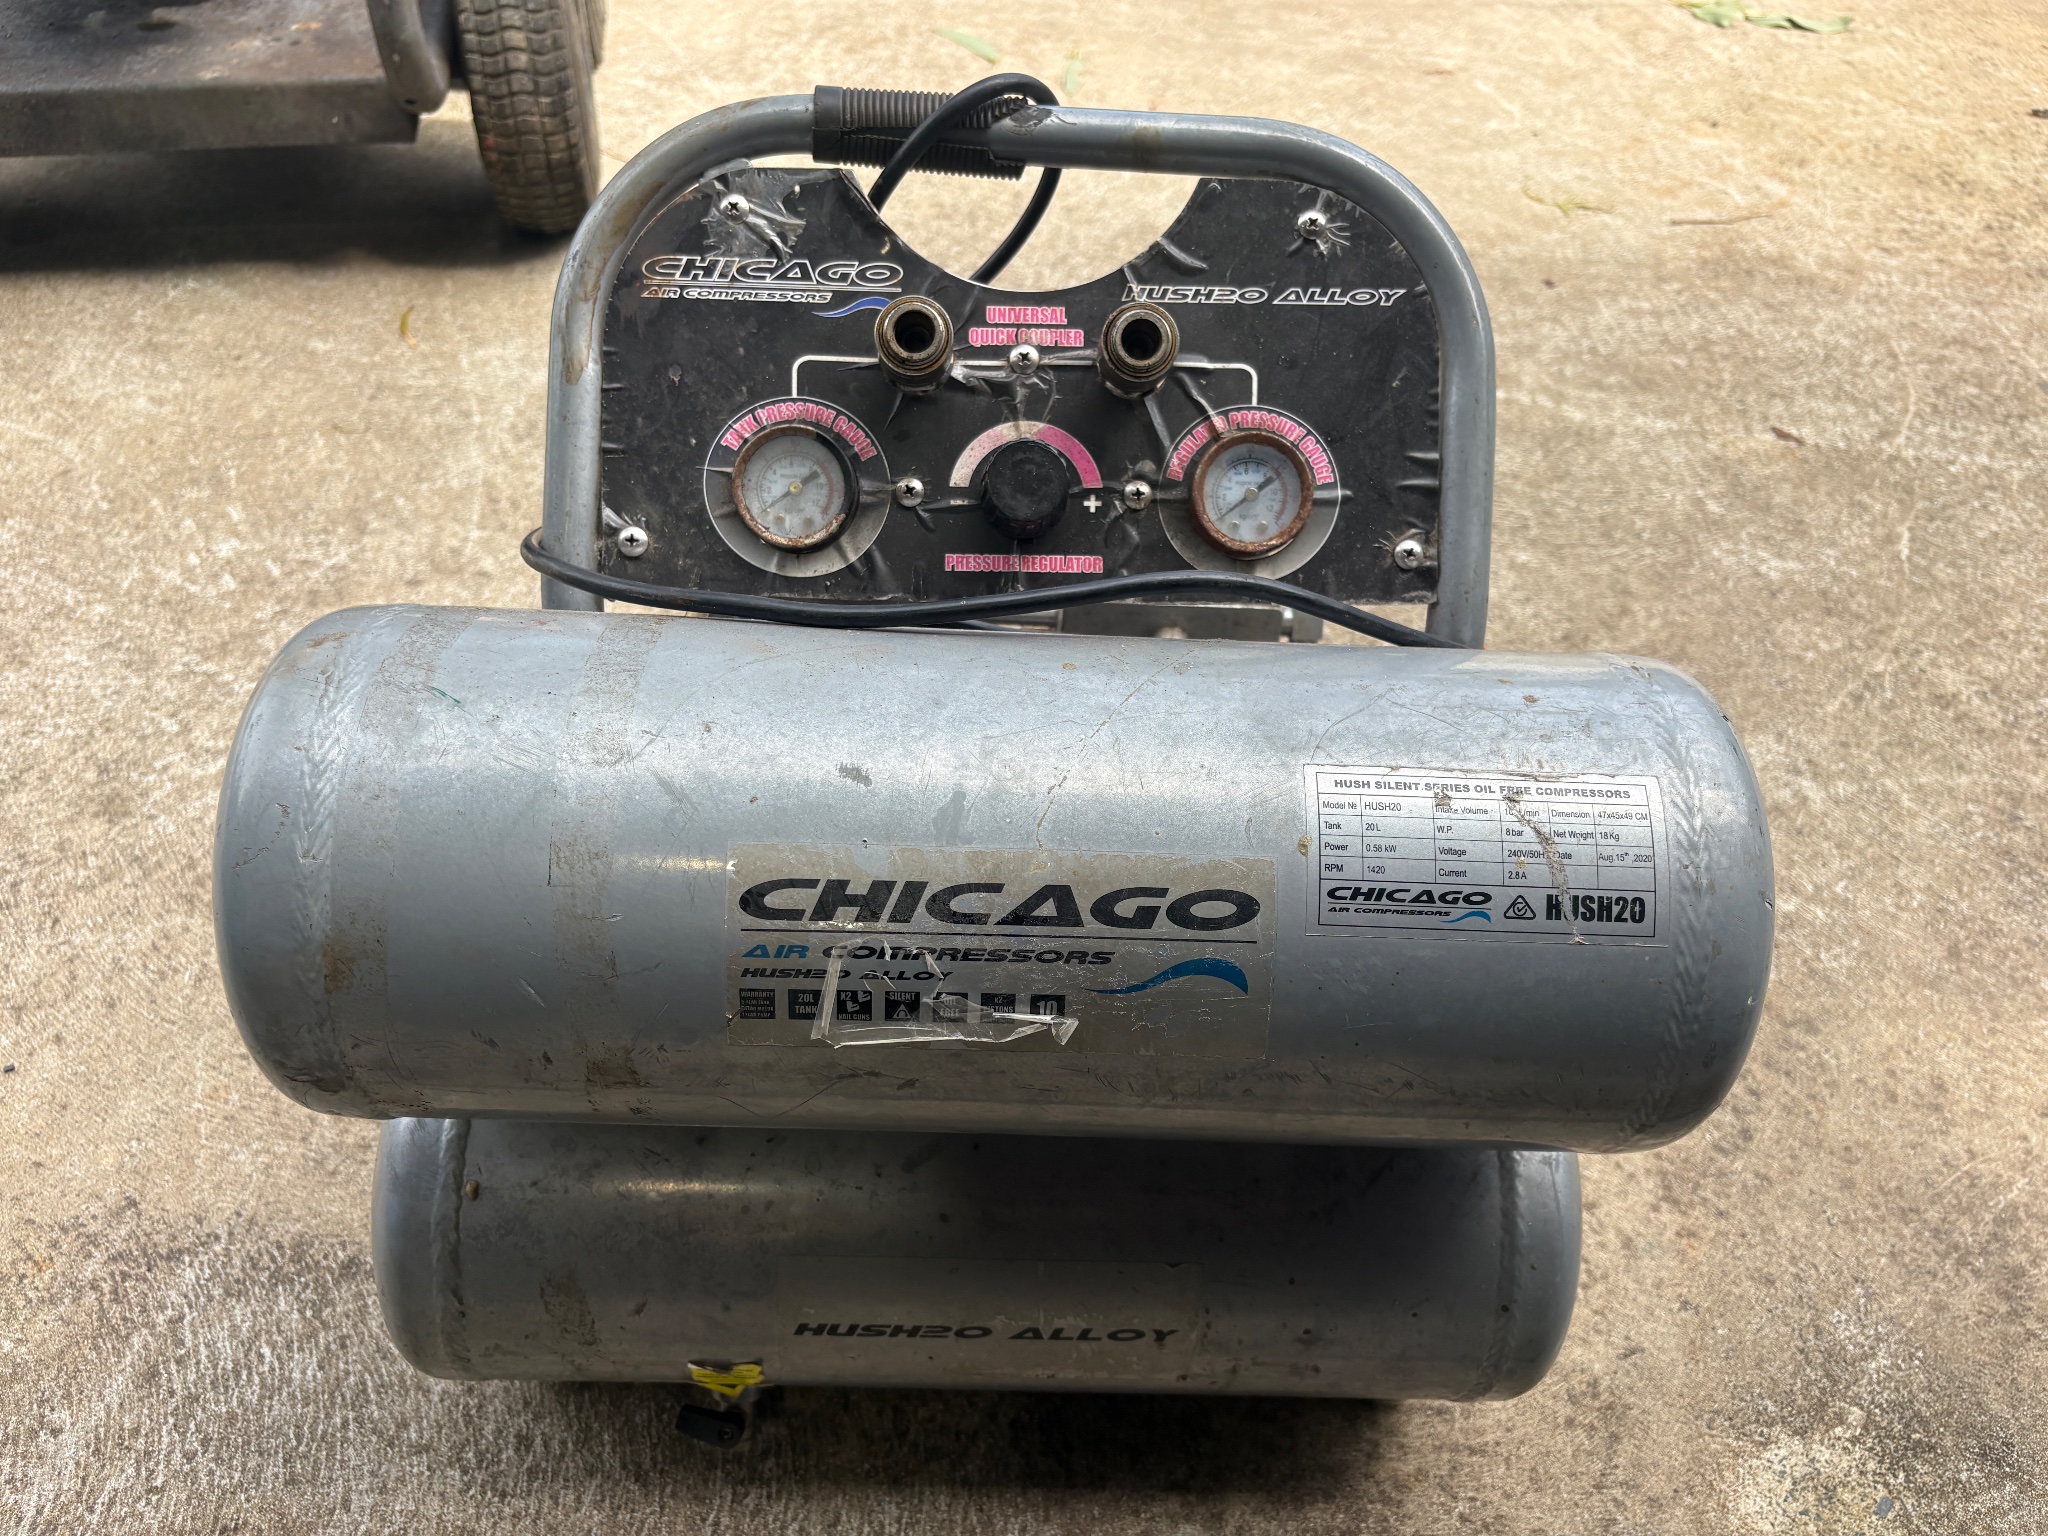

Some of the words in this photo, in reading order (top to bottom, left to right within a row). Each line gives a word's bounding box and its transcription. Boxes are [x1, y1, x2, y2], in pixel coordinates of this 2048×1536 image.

[641, 255, 904, 287] CHICAGO
[641, 287, 680, 298] AIR
[683, 288, 833, 303] COMPRESSORS
[1120, 284, 1269, 304] HUSH20
[1272, 287, 1407, 306] ALLOY
[986, 306, 1067, 325] UNIVERSAL
[968, 328, 1017, 347] QUICK
[1018, 329, 1085, 347] COUPLER
[720, 413, 760, 451] TANK
[755, 402, 837, 428] PRESSURE
[832, 415, 878, 462] GAUGE
[1228, 411, 1307, 444] PRESSURE
[1298, 436, 1335, 485] GAUGE
[945, 554, 1019, 572] PRESSURE
[1021, 555, 1104, 573] REGULATOR
[1334, 779, 1371, 789] HUSH
[1473, 785, 1496, 794] OIL
[1535, 787, 1631, 799] COMPRESSORS
[1322, 801, 1345, 810] Model
[1364, 802, 1401, 811] HUSH20
[1460, 807, 1489, 816] Volume
[1551, 809, 1591, 819] Dimension
[1597, 811, 1633, 821] 47x45x49
[1634, 813, 1648, 822] CM
[1324, 821, 1342, 830] Tank
[1437, 825, 1454, 834] W.P.
[1553, 830, 1567, 839] Net
[1324, 842, 1349, 851] Power
[1365, 844, 1383, 853] 0.58
[1384, 844, 1397, 853] kW
[1438, 847, 1467, 857] Voltage
[1324, 864, 1344, 873] RPM
[1367, 866, 1386, 874] 1420
[1438, 869, 1467, 878] Current
[1327, 886, 1493, 906] CHICAGO
[739, 877, 1260, 931] CHICAGO
[1546, 893, 1646, 924] HUSH20
[1327, 906, 1350, 914] AIR
[1353, 907, 1452, 917] COMPRESSORS
[741, 944, 810, 959] AIR
[822, 945, 1115, 965] COMPRESSORS
[858, 969, 953, 981] ALLOY
[798, 993, 814, 1003] 20L
[840, 992, 852, 1000] X2
[889, 991, 916, 1001] SILENT
[795, 1005, 817, 1014] TANK
[940, 1008, 960, 1017] FREE
[794, 1323, 992, 1338] HUSH20
[1008, 1327, 1179, 1341] ALLOY
